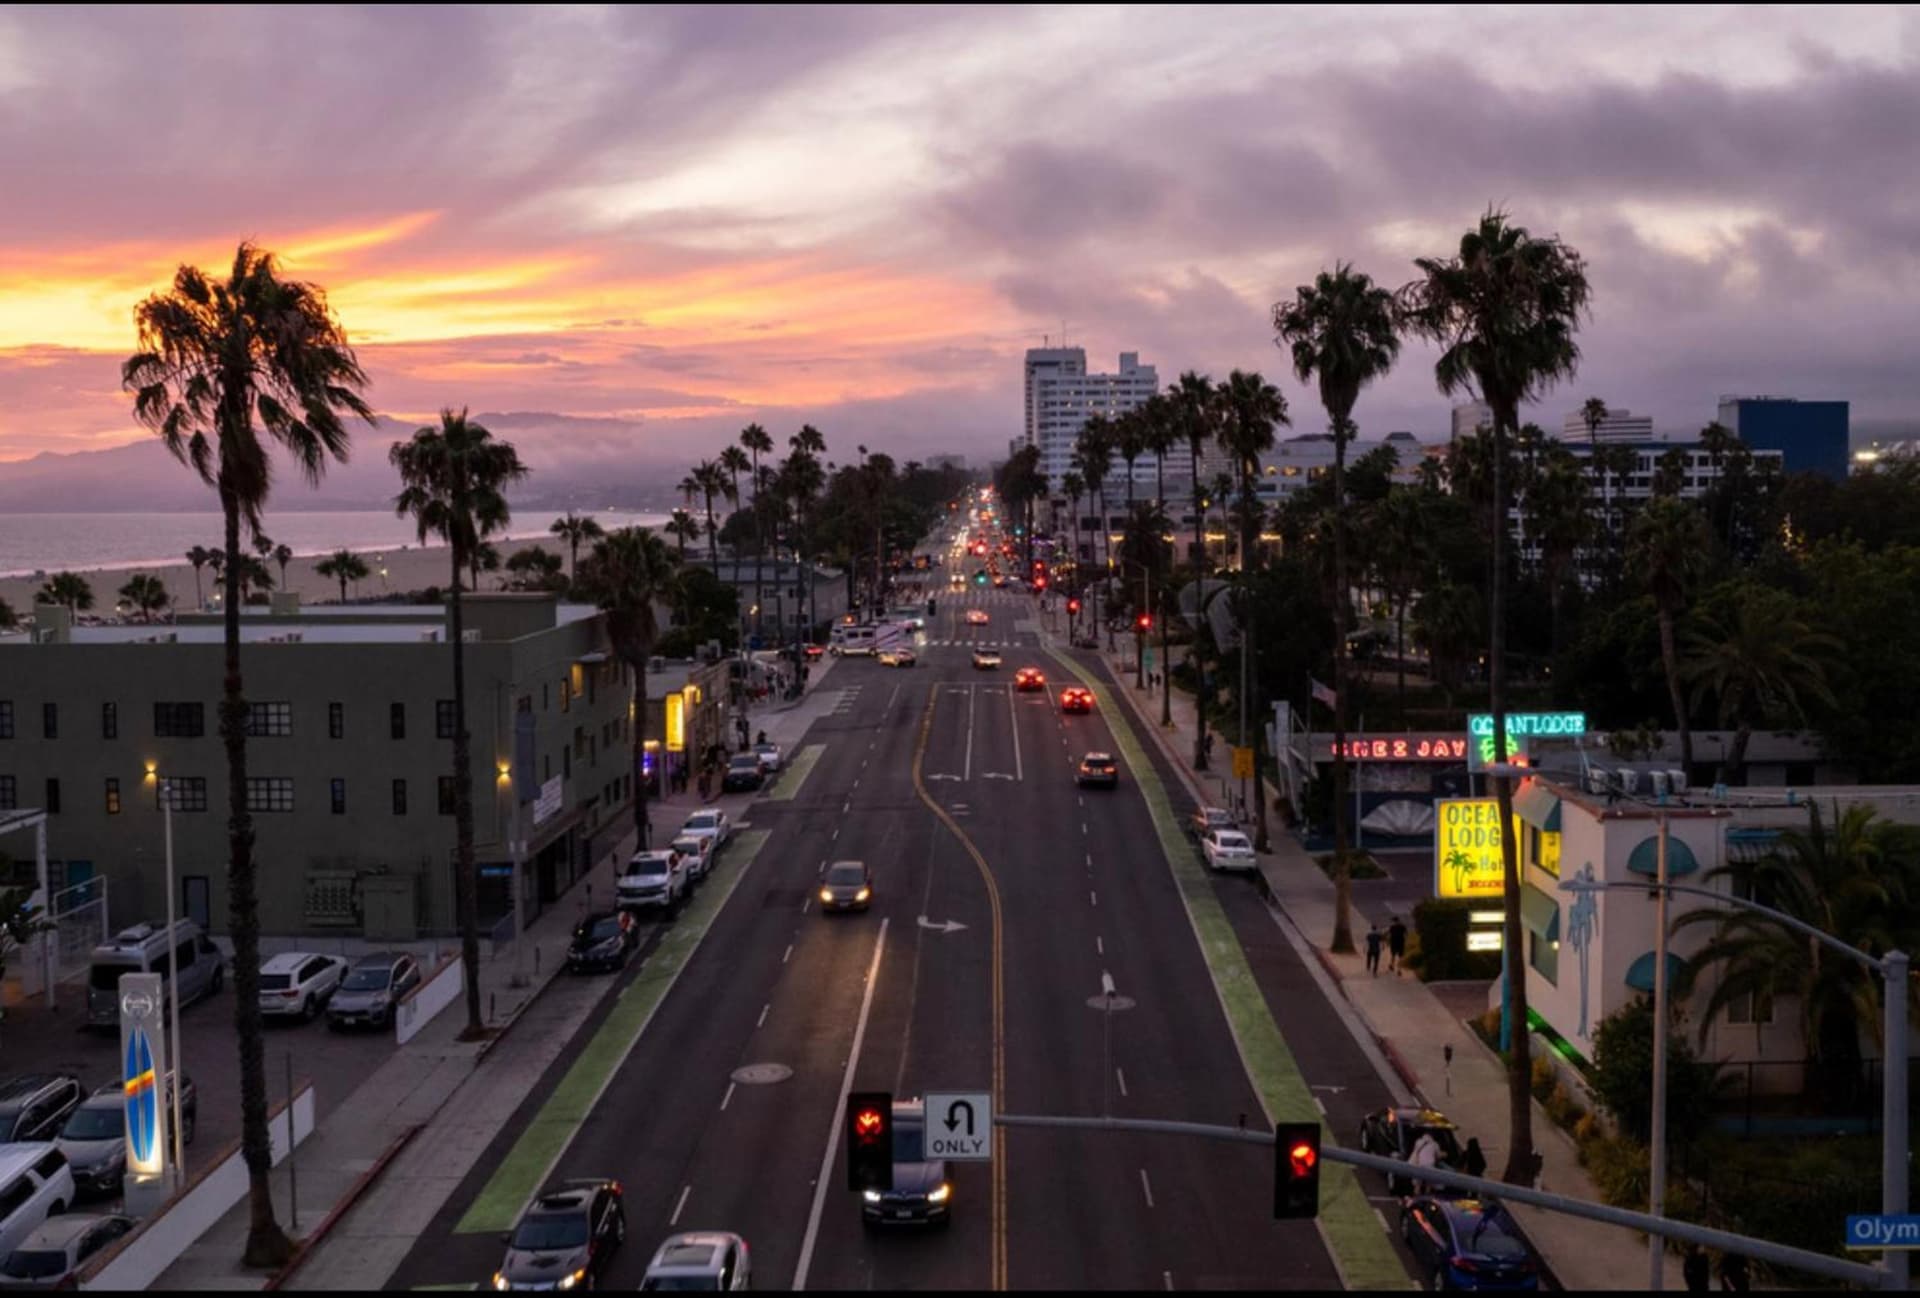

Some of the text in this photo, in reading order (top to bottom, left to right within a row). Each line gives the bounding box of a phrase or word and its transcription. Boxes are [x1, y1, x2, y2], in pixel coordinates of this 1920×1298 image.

[1471, 713, 1585, 734] OCAN LODGE
[1416, 739, 1465, 757] JAY
[1447, 804, 1499, 825] OCEA
[1449, 827, 1501, 848] LODG
[932, 1139, 984, 1154] ONLY
[1855, 1219, 1920, 1243] Olym
